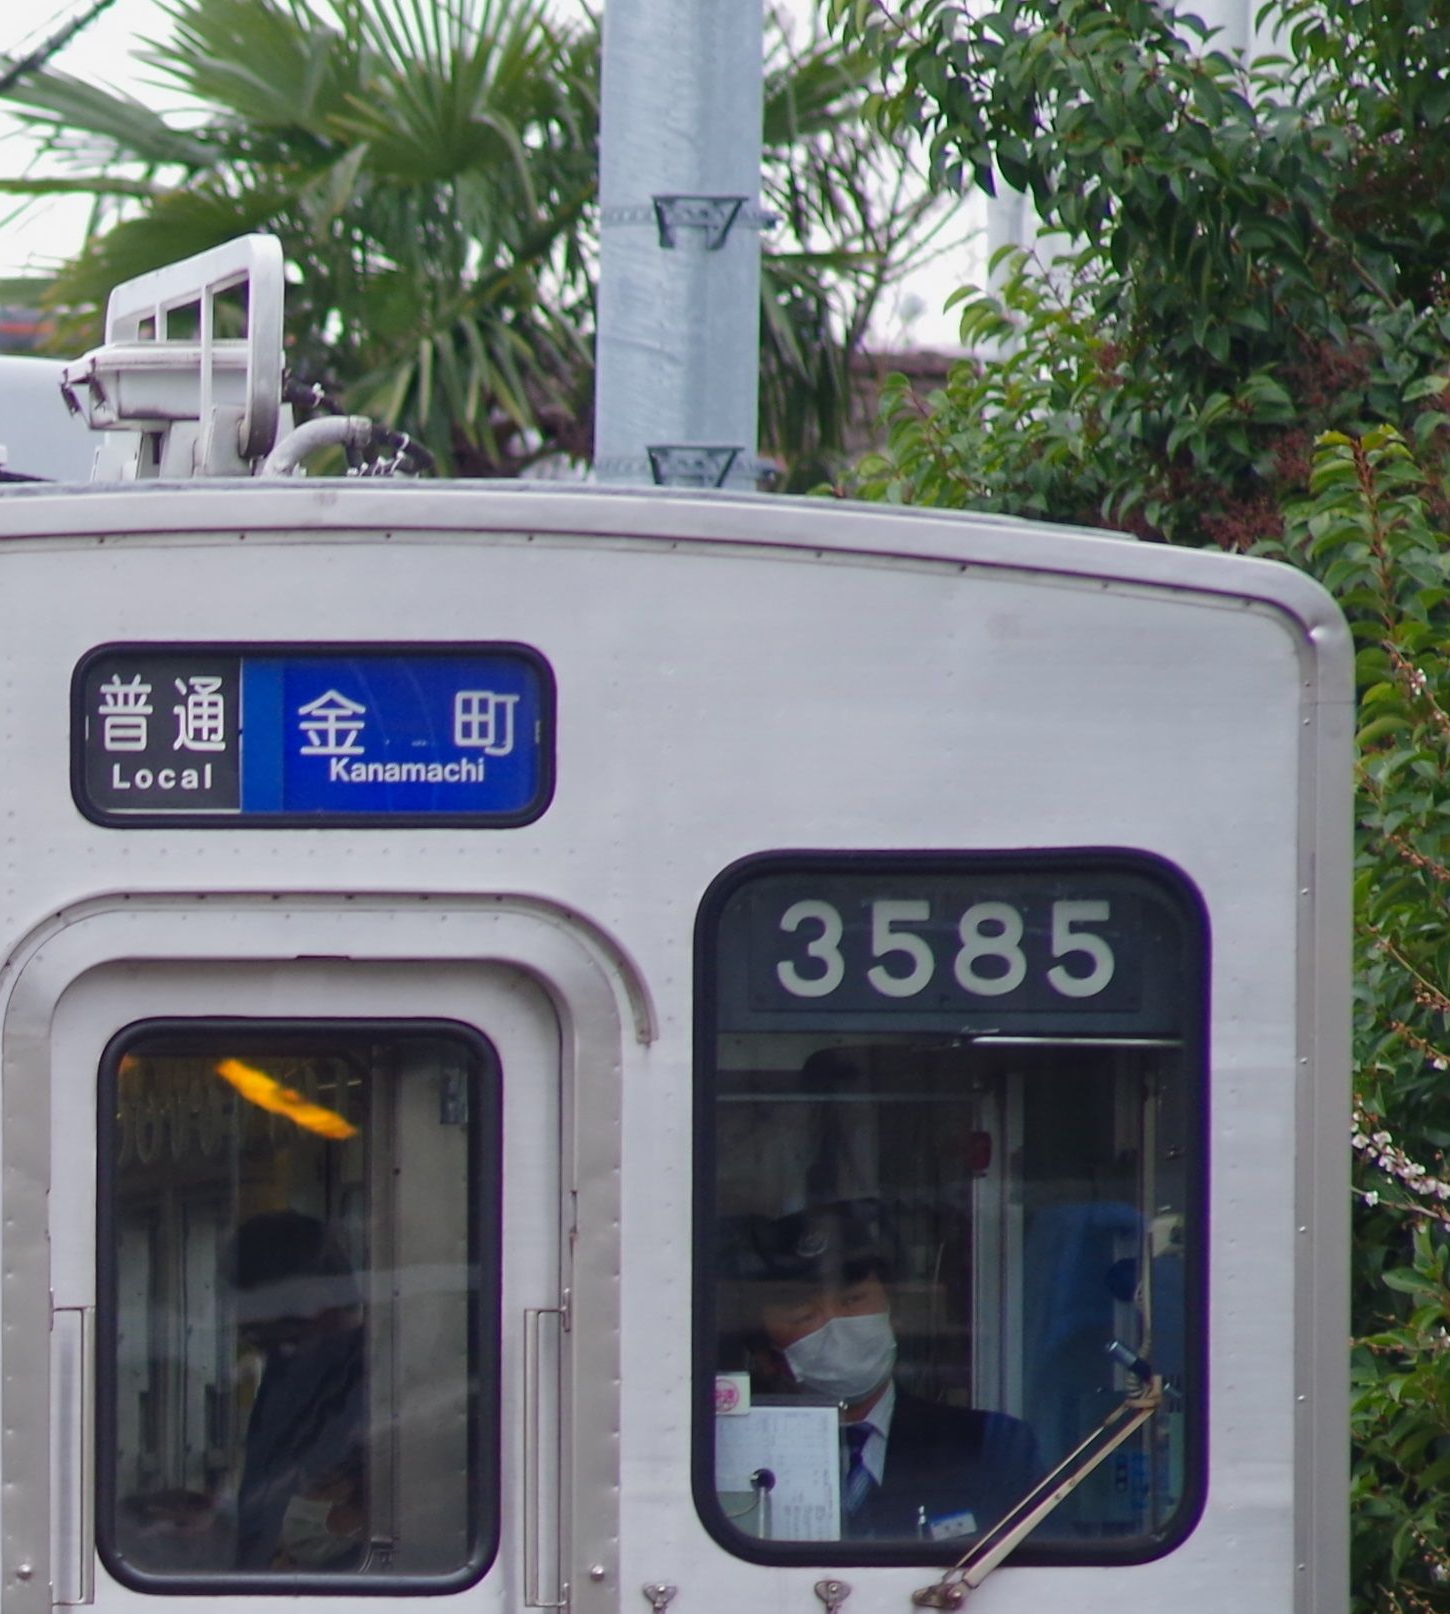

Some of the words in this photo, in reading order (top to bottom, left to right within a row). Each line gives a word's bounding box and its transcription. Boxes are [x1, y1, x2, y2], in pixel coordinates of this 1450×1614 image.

[98, 674, 227, 752] 普通
[298, 689, 520, 756] 金町
[112, 763, 212, 790] Local
[329, 757, 485, 783] Kanamachi
[776, 900, 1115, 998] 3585
